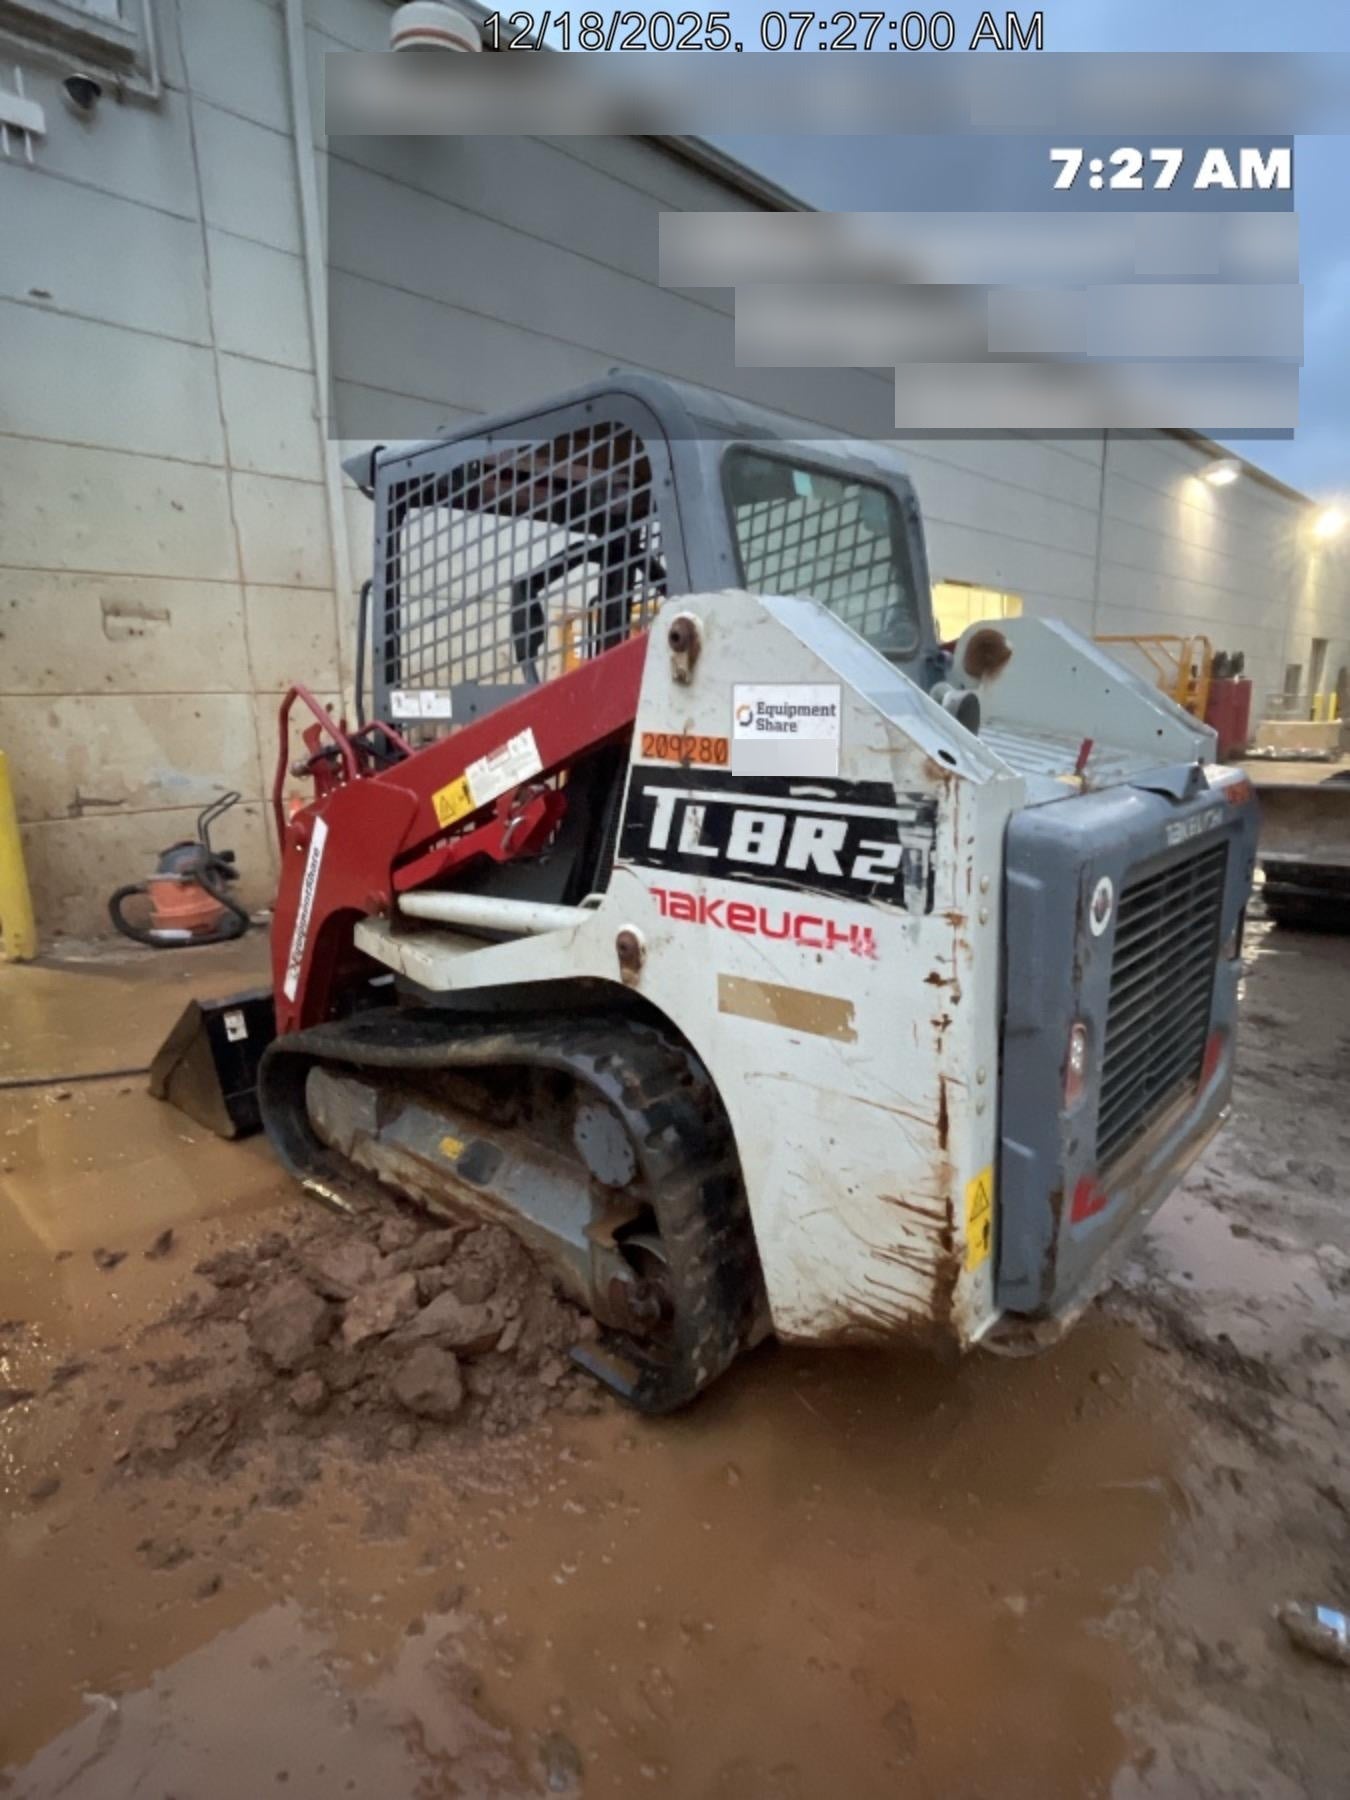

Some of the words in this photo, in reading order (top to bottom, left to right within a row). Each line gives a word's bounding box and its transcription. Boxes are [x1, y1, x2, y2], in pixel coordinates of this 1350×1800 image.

[756, 701, 837, 721] Equipment
[755, 718, 798, 733] Share
[641, 733, 729, 765] 209280
